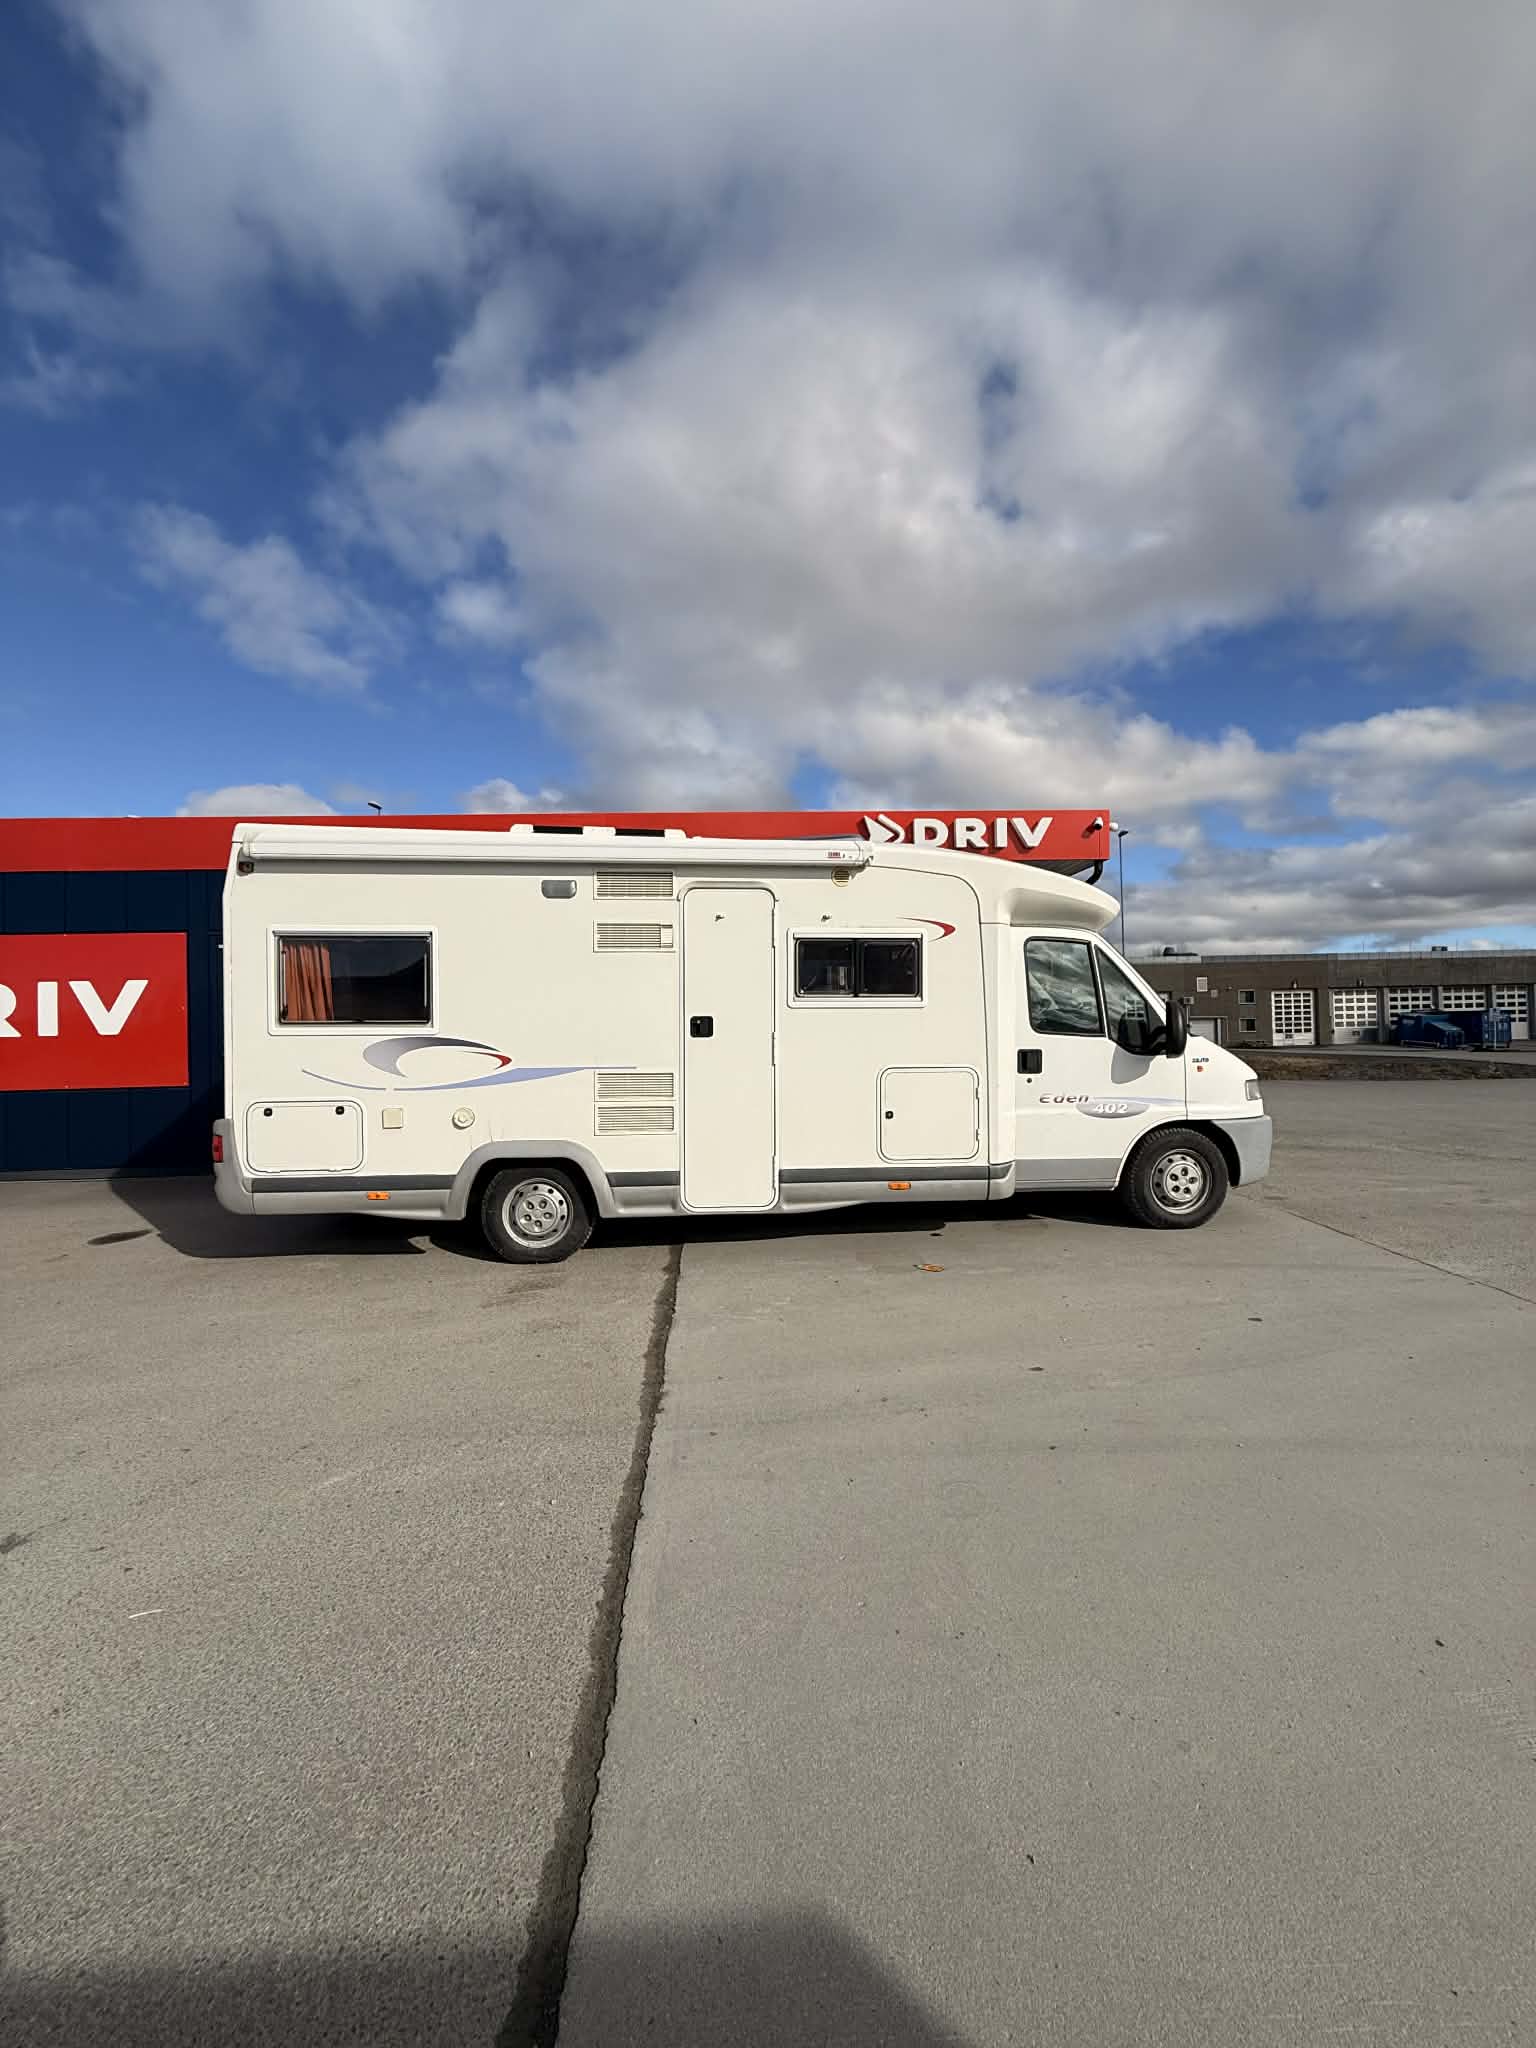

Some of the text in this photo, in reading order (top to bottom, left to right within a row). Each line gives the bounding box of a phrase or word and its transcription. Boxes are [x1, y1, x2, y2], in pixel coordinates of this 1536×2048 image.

[913, 817, 1053, 848] DRIV
[1039, 1092, 1089, 1103] Eden
[1093, 1103, 1128, 1113] 402
